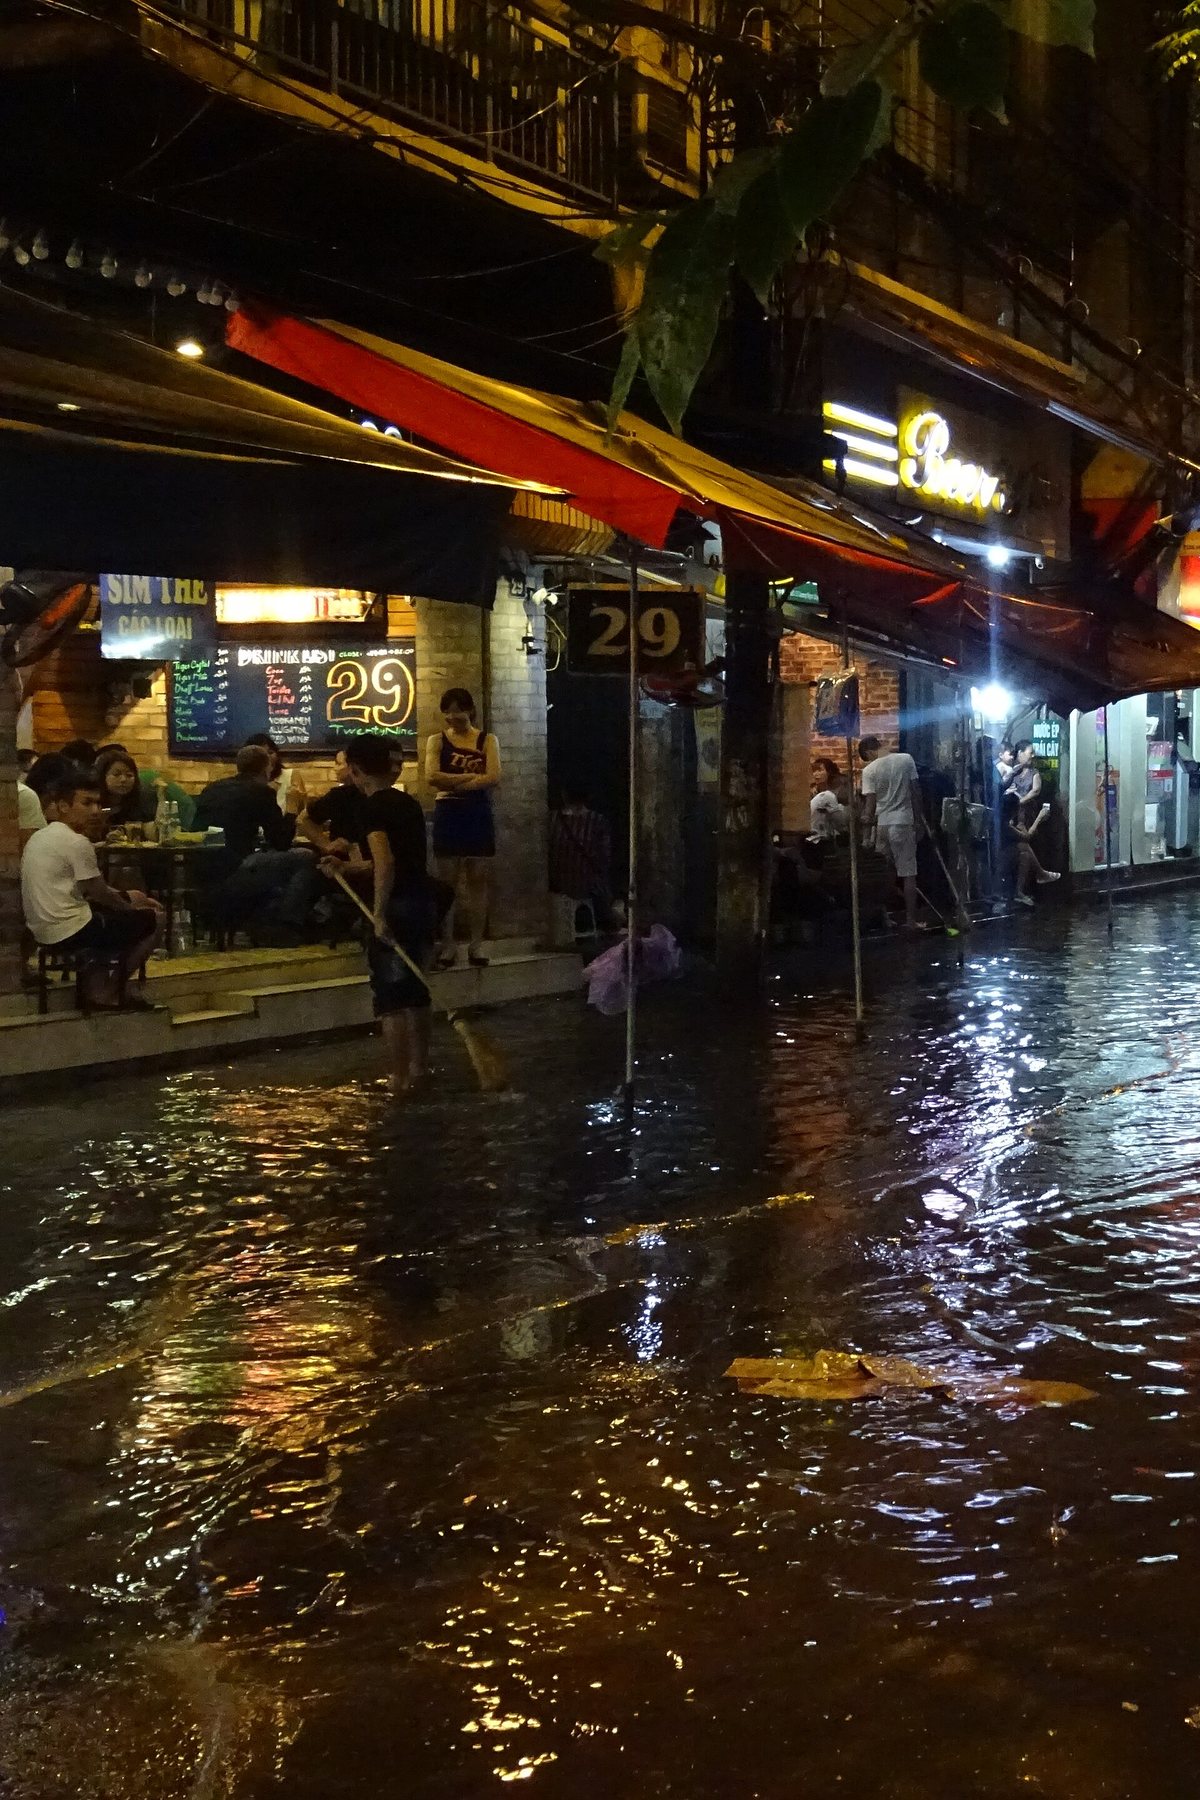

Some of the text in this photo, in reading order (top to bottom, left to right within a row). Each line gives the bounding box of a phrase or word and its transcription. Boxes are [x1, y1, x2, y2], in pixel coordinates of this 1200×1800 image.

[107, 573, 152, 605] SIM
[587, 606, 683, 658] 29
[238, 647, 300, 667] DRINK
[327, 658, 415, 727] 29
